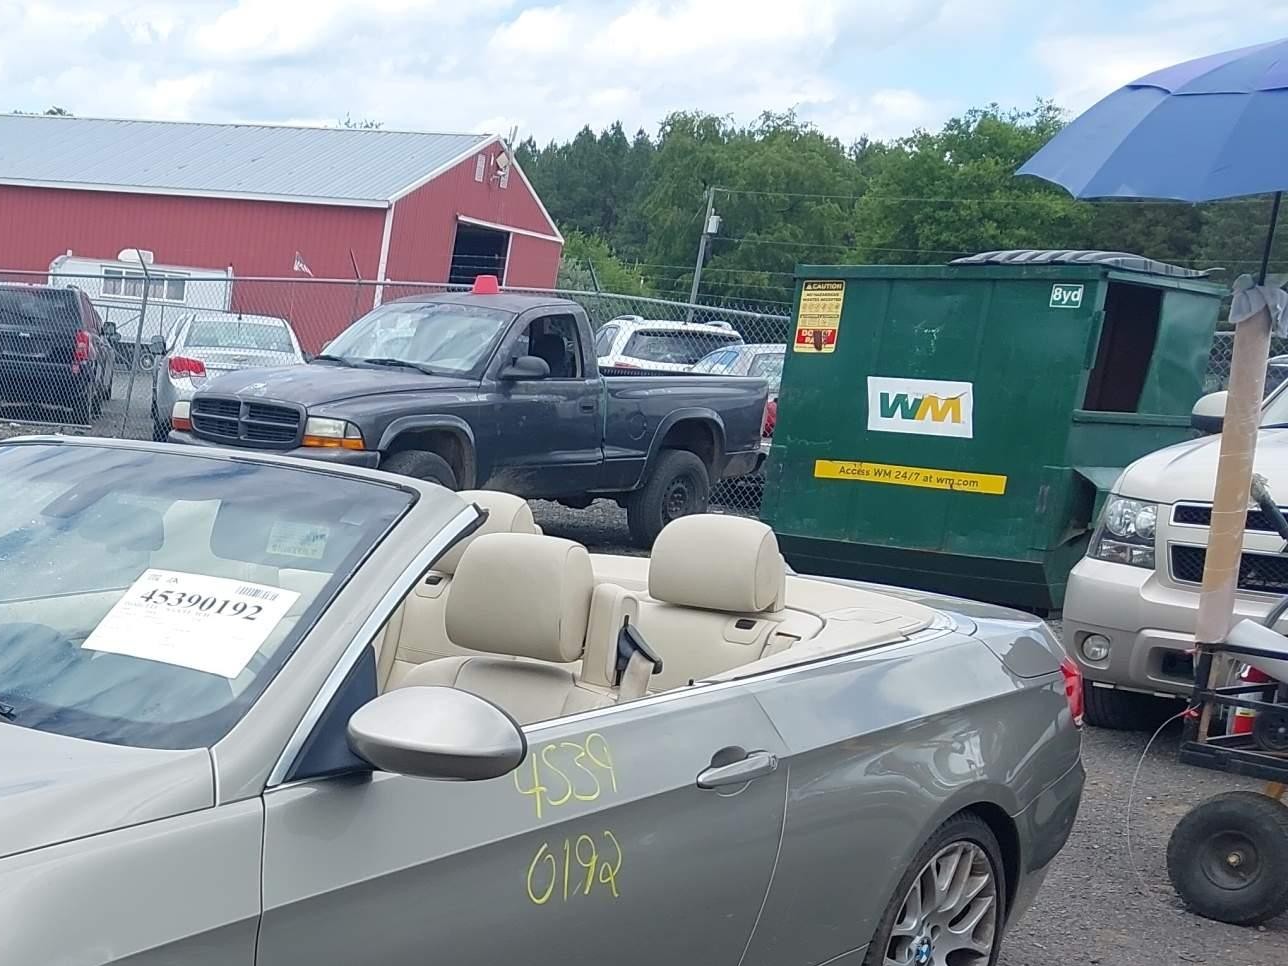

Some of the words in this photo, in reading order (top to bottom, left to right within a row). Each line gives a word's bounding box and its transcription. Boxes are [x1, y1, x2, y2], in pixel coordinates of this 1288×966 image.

[1053, 287, 1082, 304] 8yd
[879, 392, 961, 424] WM
[838, 465, 870, 477] Access
[874, 468, 892, 479] WM
[895, 470, 920, 482] 24/7
[922, 474, 933, 483] at
[936, 476, 979, 488] wm.com
[140, 588, 264, 621] 45390192
[514, 732, 618, 819] 4539
[527, 830, 623, 905] 0192
